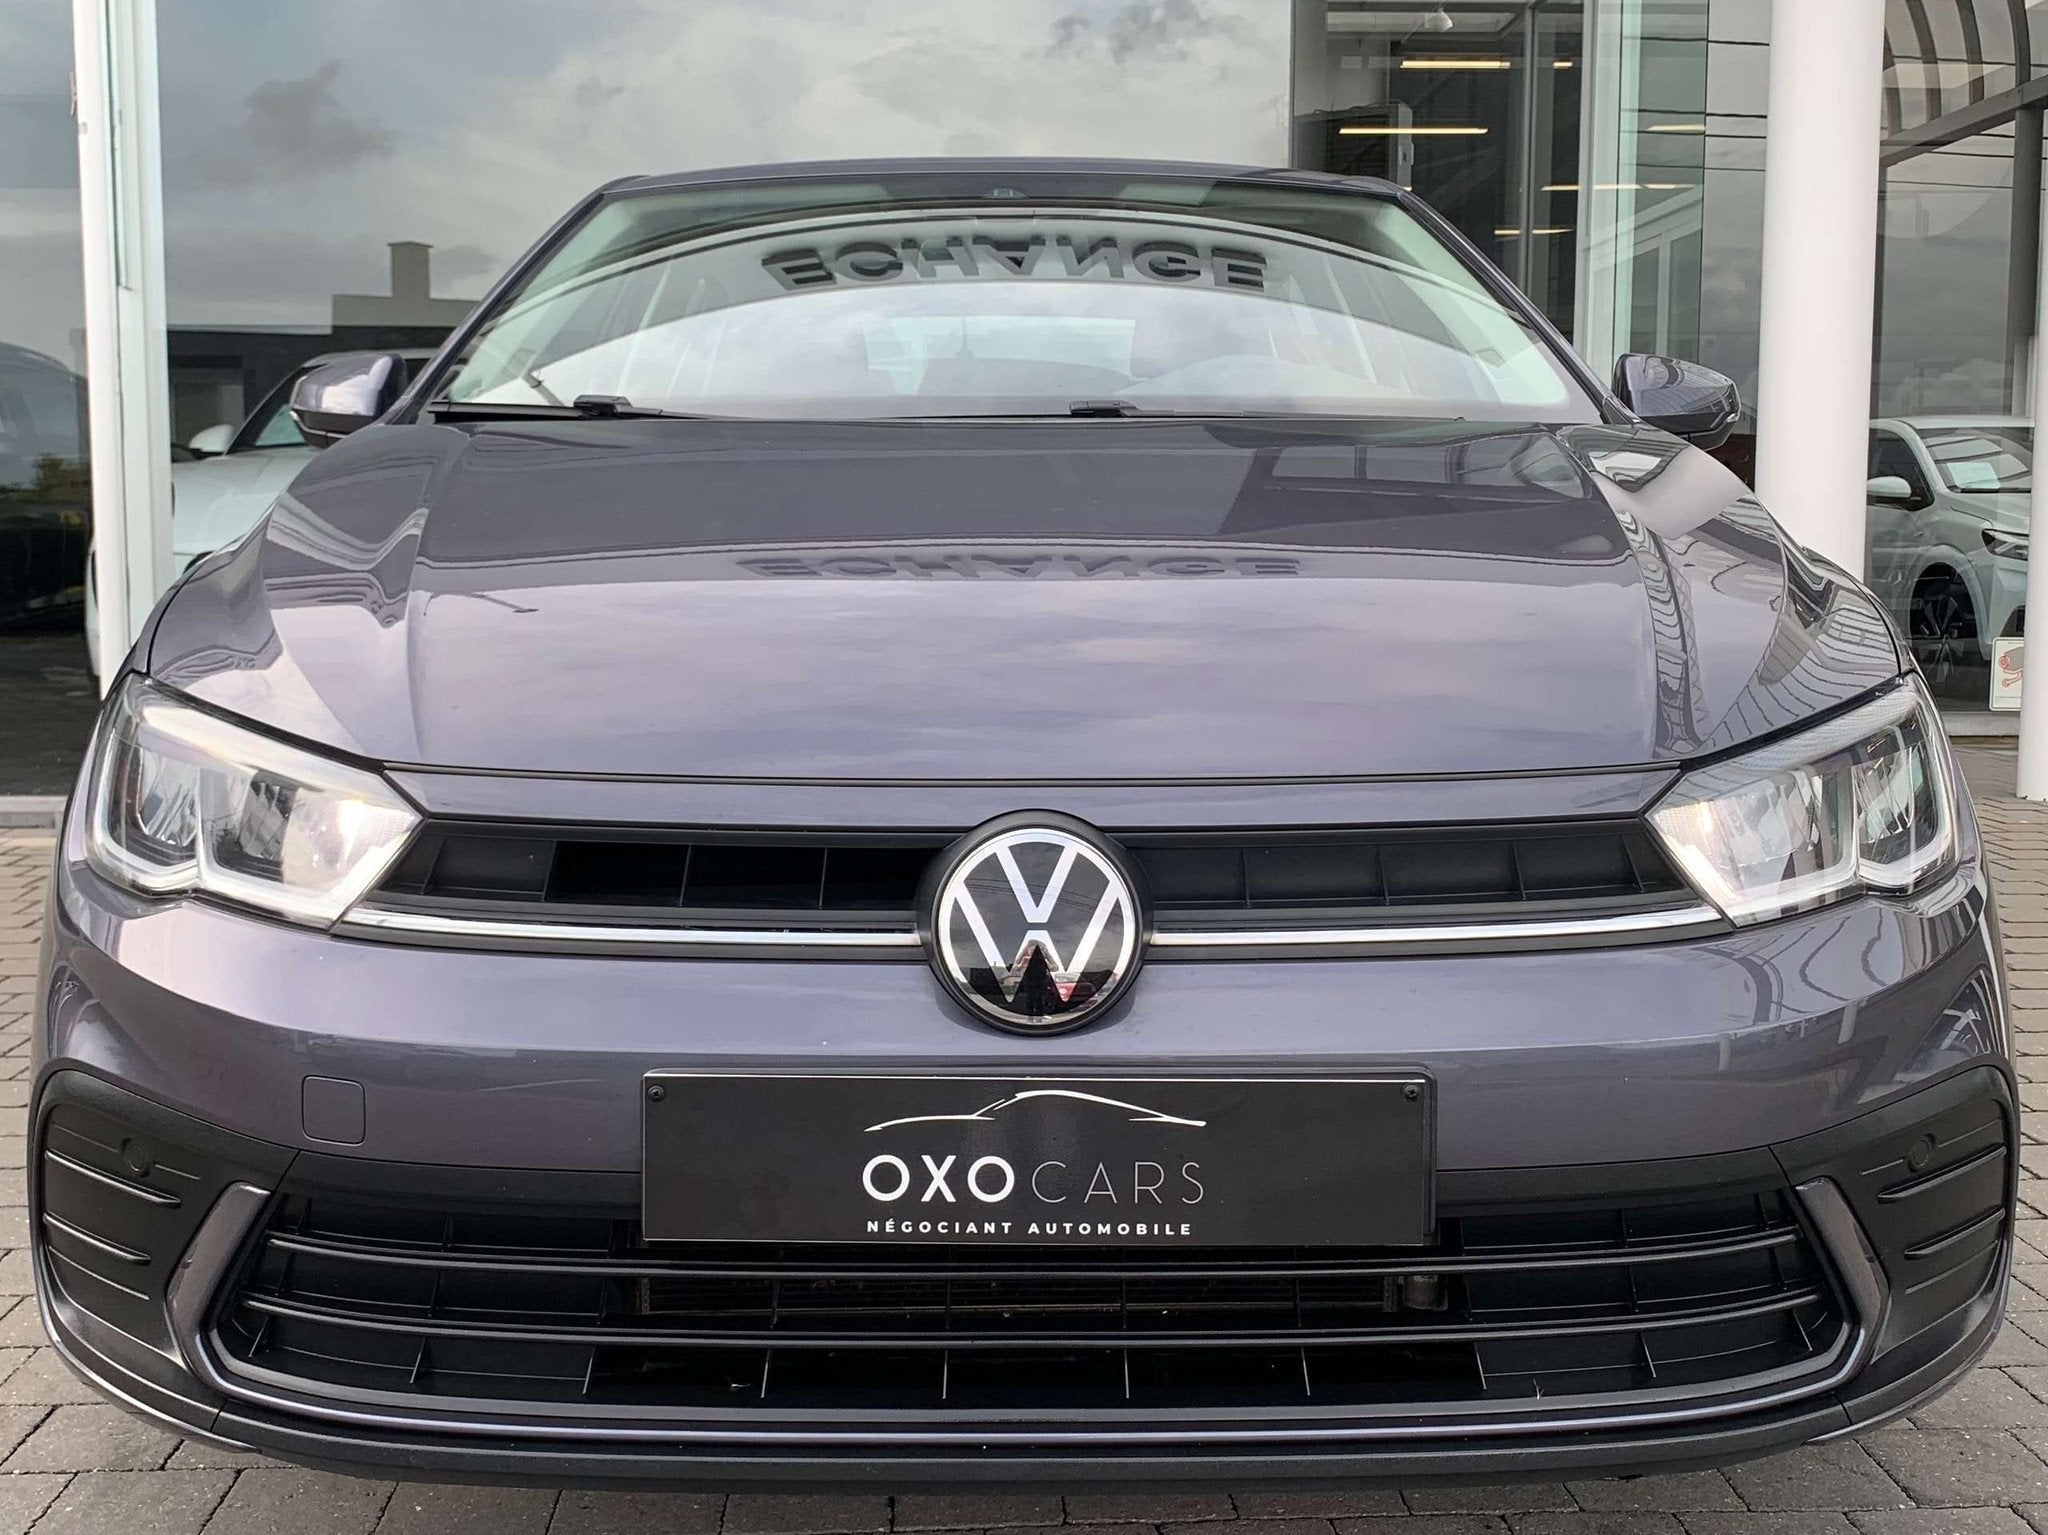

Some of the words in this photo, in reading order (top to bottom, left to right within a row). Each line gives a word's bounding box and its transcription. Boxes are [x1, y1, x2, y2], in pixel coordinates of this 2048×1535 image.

[862, 1154, 1016, 1203] OXO
[1031, 1160, 1204, 1204] CARS
[866, 1218, 1012, 1235] NÉGOCIANT
[1027, 1221, 1192, 1236] AUTOMOBILE
